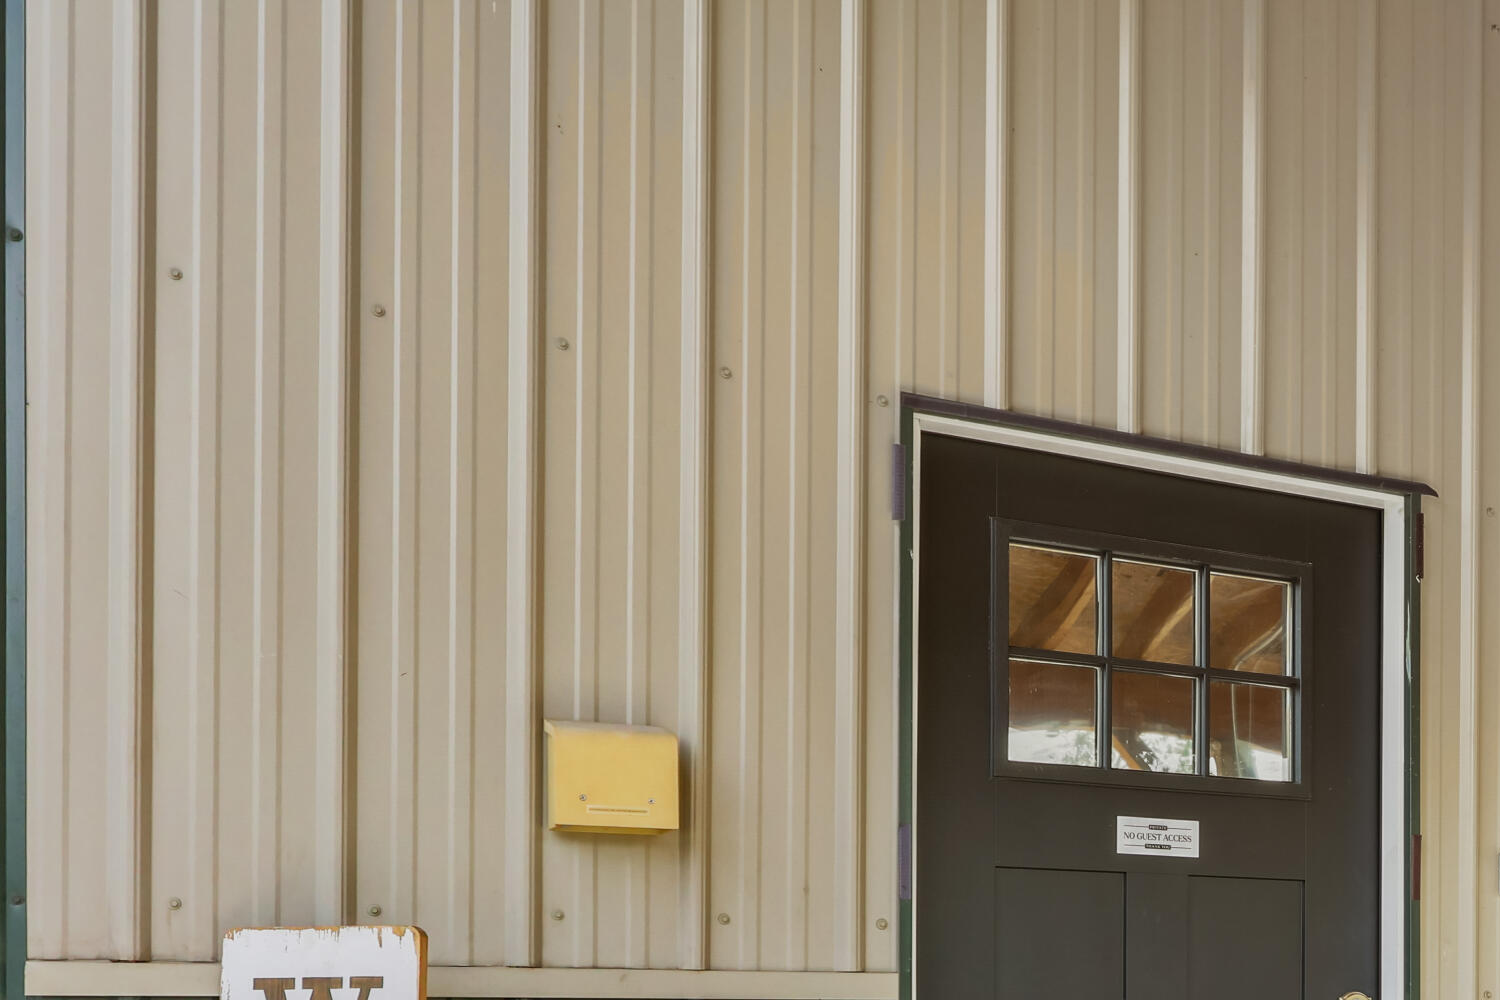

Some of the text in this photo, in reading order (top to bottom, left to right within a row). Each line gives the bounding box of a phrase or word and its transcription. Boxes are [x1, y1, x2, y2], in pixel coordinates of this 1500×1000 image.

[1123, 831, 1192, 843] NO GUEST ACCESS
